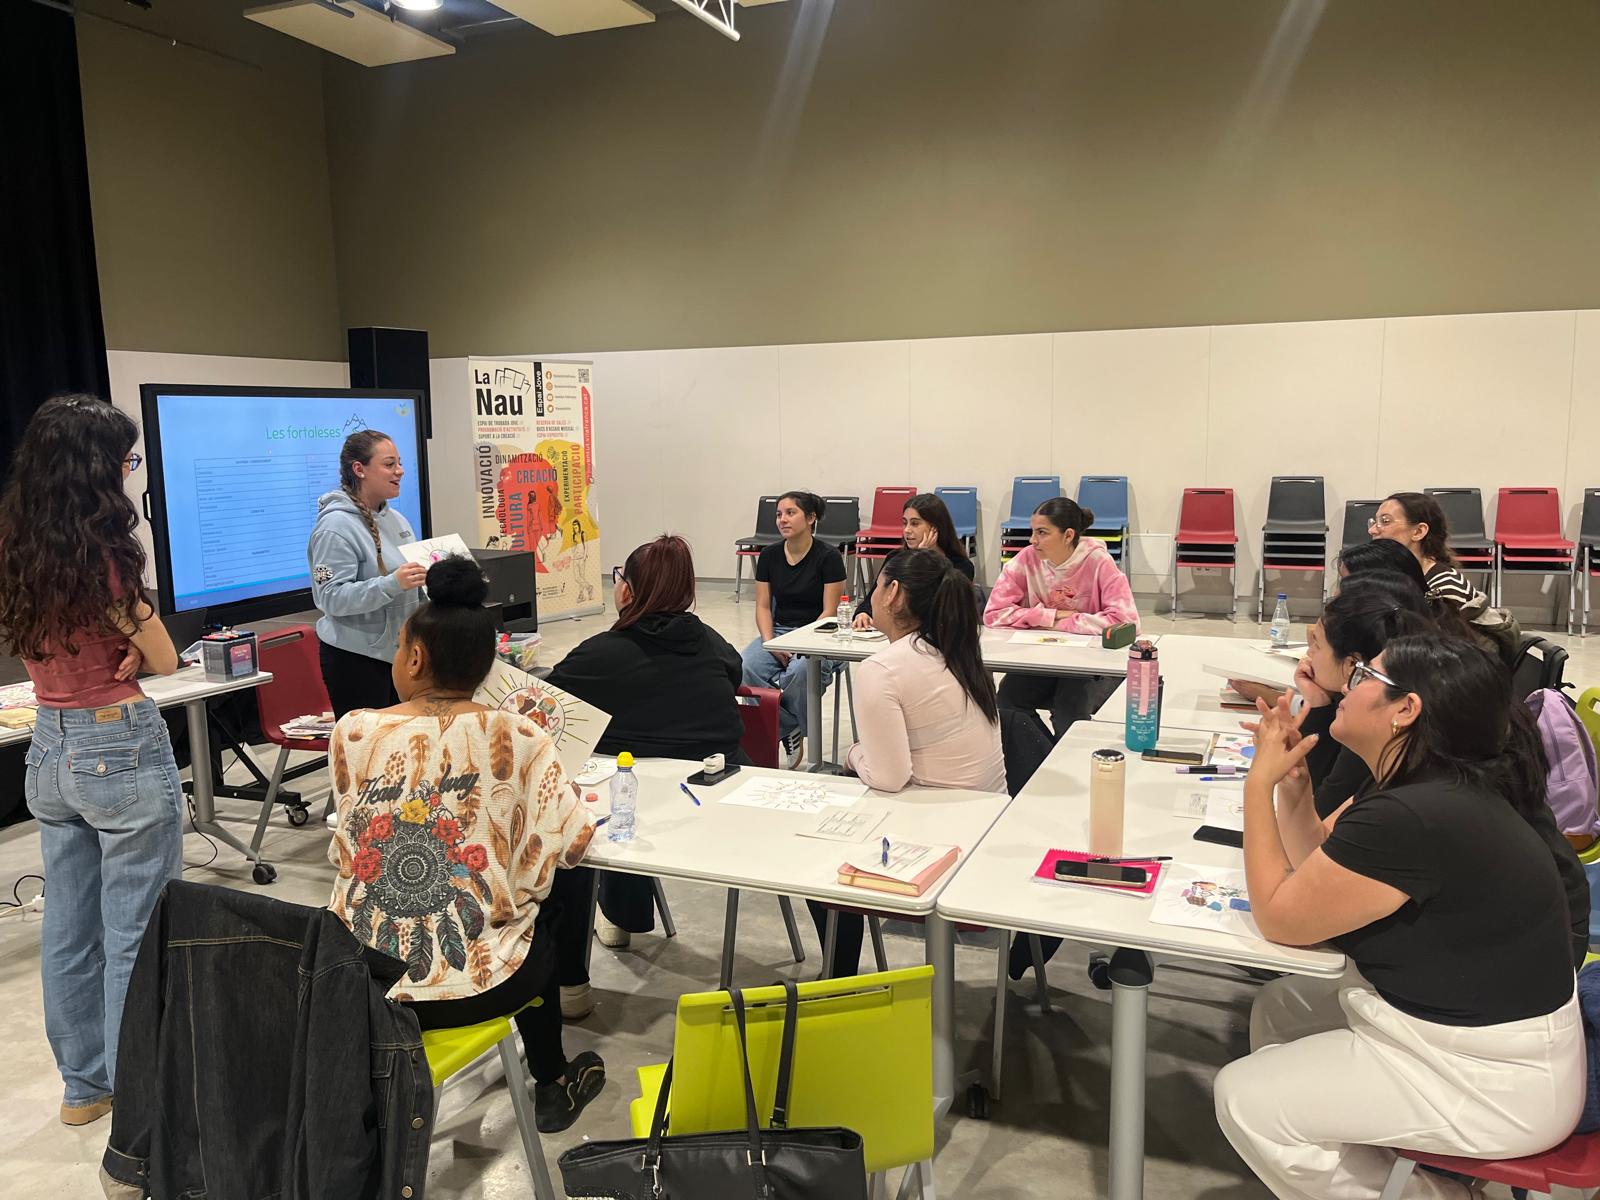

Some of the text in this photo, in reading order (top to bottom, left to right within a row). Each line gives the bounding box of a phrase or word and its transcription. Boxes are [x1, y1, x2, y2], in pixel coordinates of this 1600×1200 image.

[474, 369, 490, 384] La
[476, 388, 523, 416] Nau
[266, 426, 341, 440] Les fortaleses
[496, 452, 543, 464] DINAMITZACIÓ
[517, 466, 557, 484] CREACIÓ
[561, 450, 570, 502] EXPERIMENTACIÓ
[476, 445, 496, 519] INNOVACIÓ
[570, 444, 583, 516] PARTICIPACIÓ
[498, 489, 507, 538] TECNOLOGIA
[509, 492, 526, 551] ULTURA
